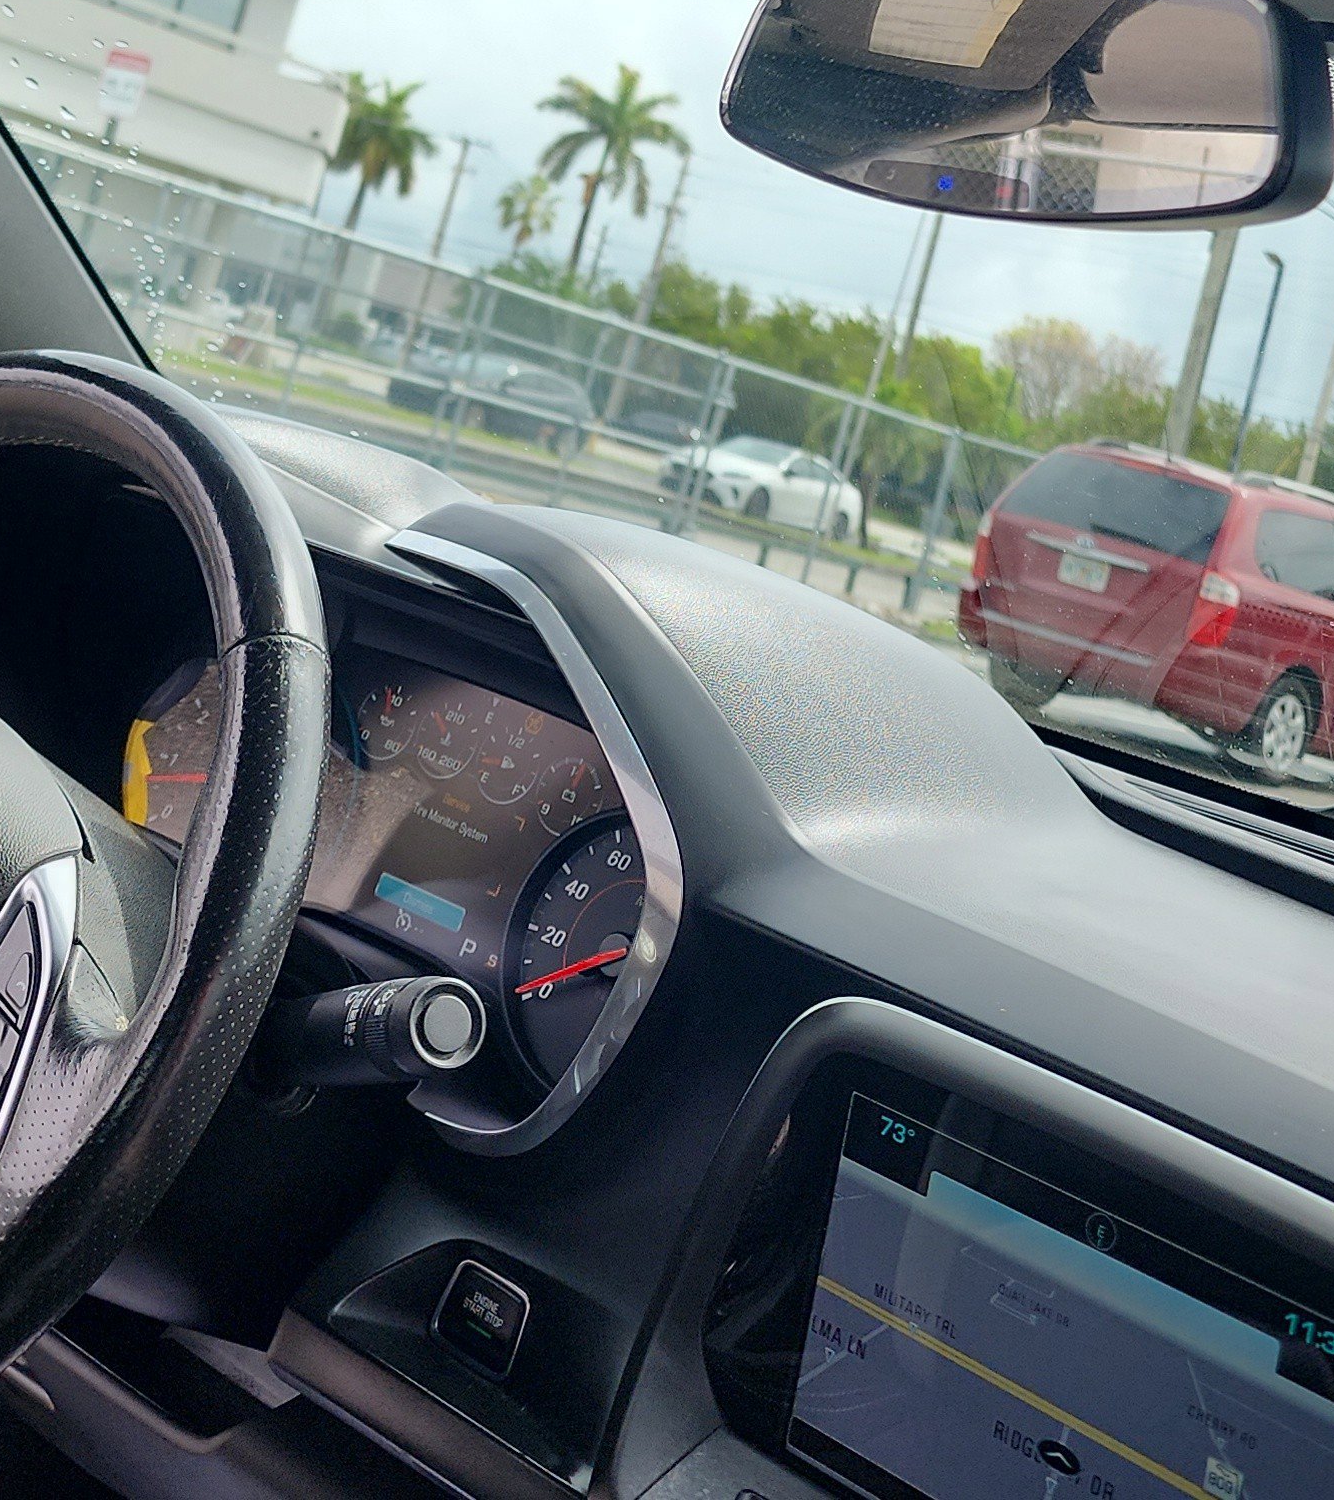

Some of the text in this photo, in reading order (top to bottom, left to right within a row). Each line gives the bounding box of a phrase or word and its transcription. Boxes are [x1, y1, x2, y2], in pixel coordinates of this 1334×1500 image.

[360, 729, 371, 742] 0
[540, 803, 551, 815] 9
[427, 808, 459, 831] Monitor
[458, 821, 489, 844] System
[607, 850, 632, 871] 60
[564, 879, 590, 901] 40
[540, 925, 567, 948] 20
[458, 938, 478, 958] P
[538, 982, 554, 1000] 0
[874, 1282, 957, 1340] MILITARY TRL
[847, 1334, 867, 1360] LN
[1090, 1474, 1114, 1500] DR
